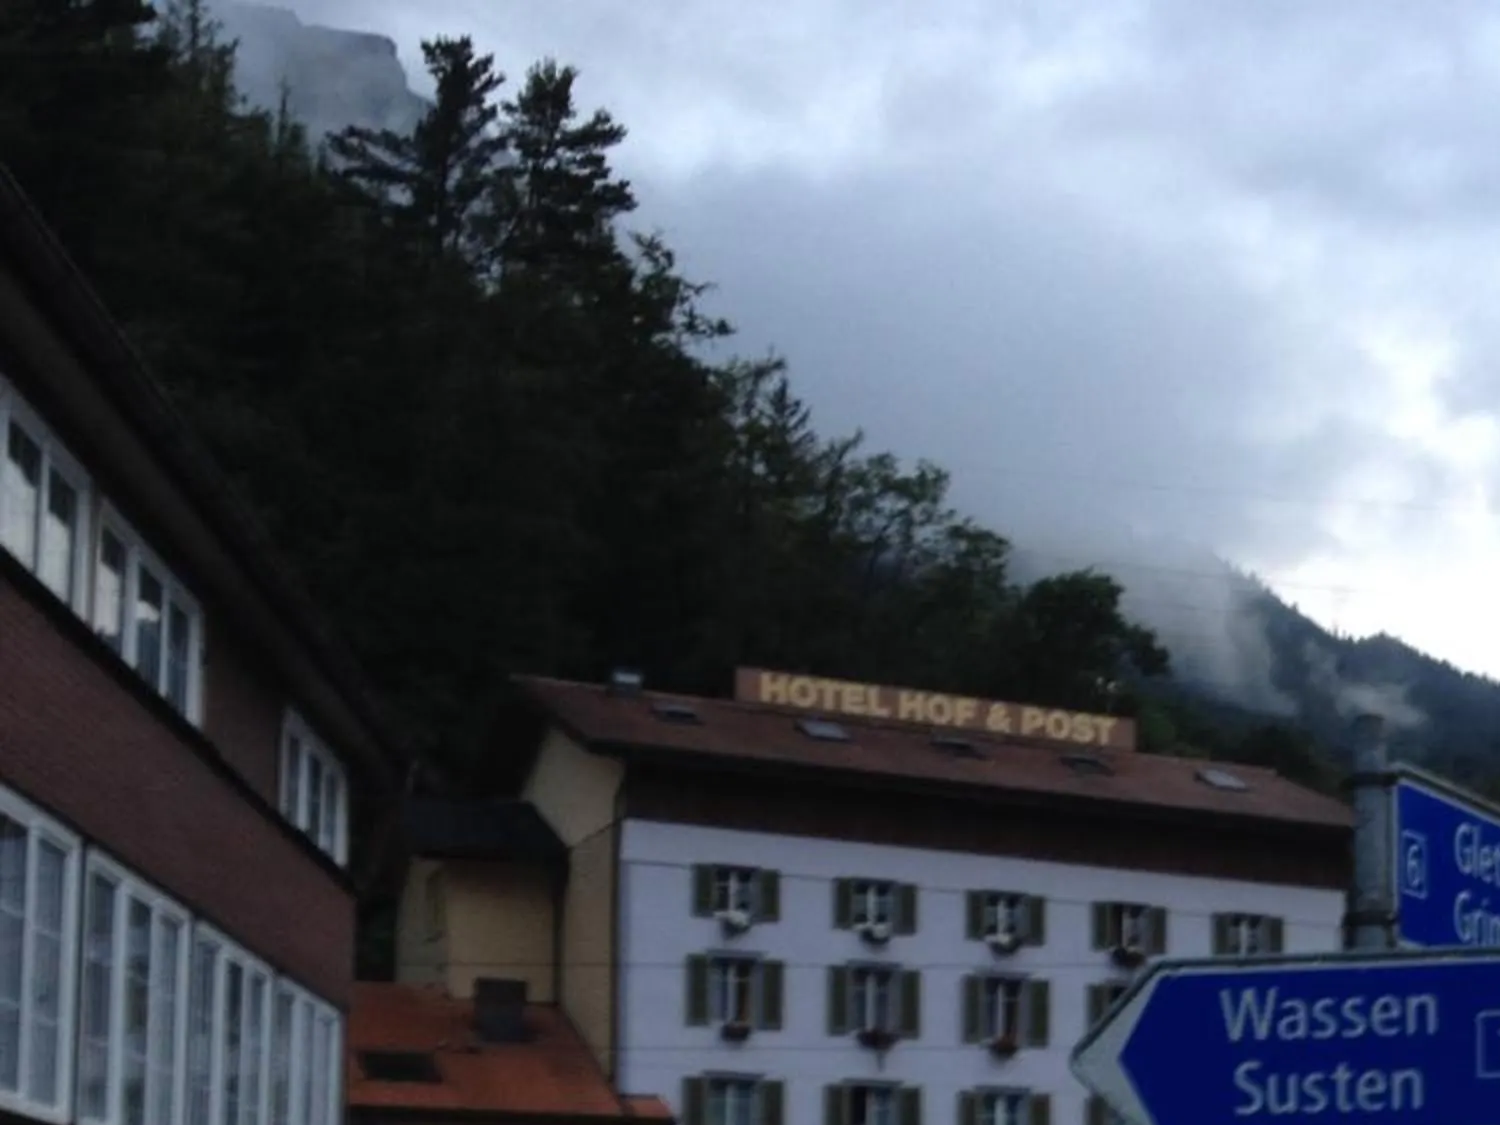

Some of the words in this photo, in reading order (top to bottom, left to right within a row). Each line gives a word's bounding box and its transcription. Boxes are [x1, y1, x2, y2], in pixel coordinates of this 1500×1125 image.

[761, 672, 890, 718] HOTEL
[898, 689, 978, 727] HOF
[985, 702, 1011, 734] &
[1020, 706, 1118, 746] POST
[1219, 986, 1438, 1043] Wassen
[1233, 1060, 1424, 1116] Susten
